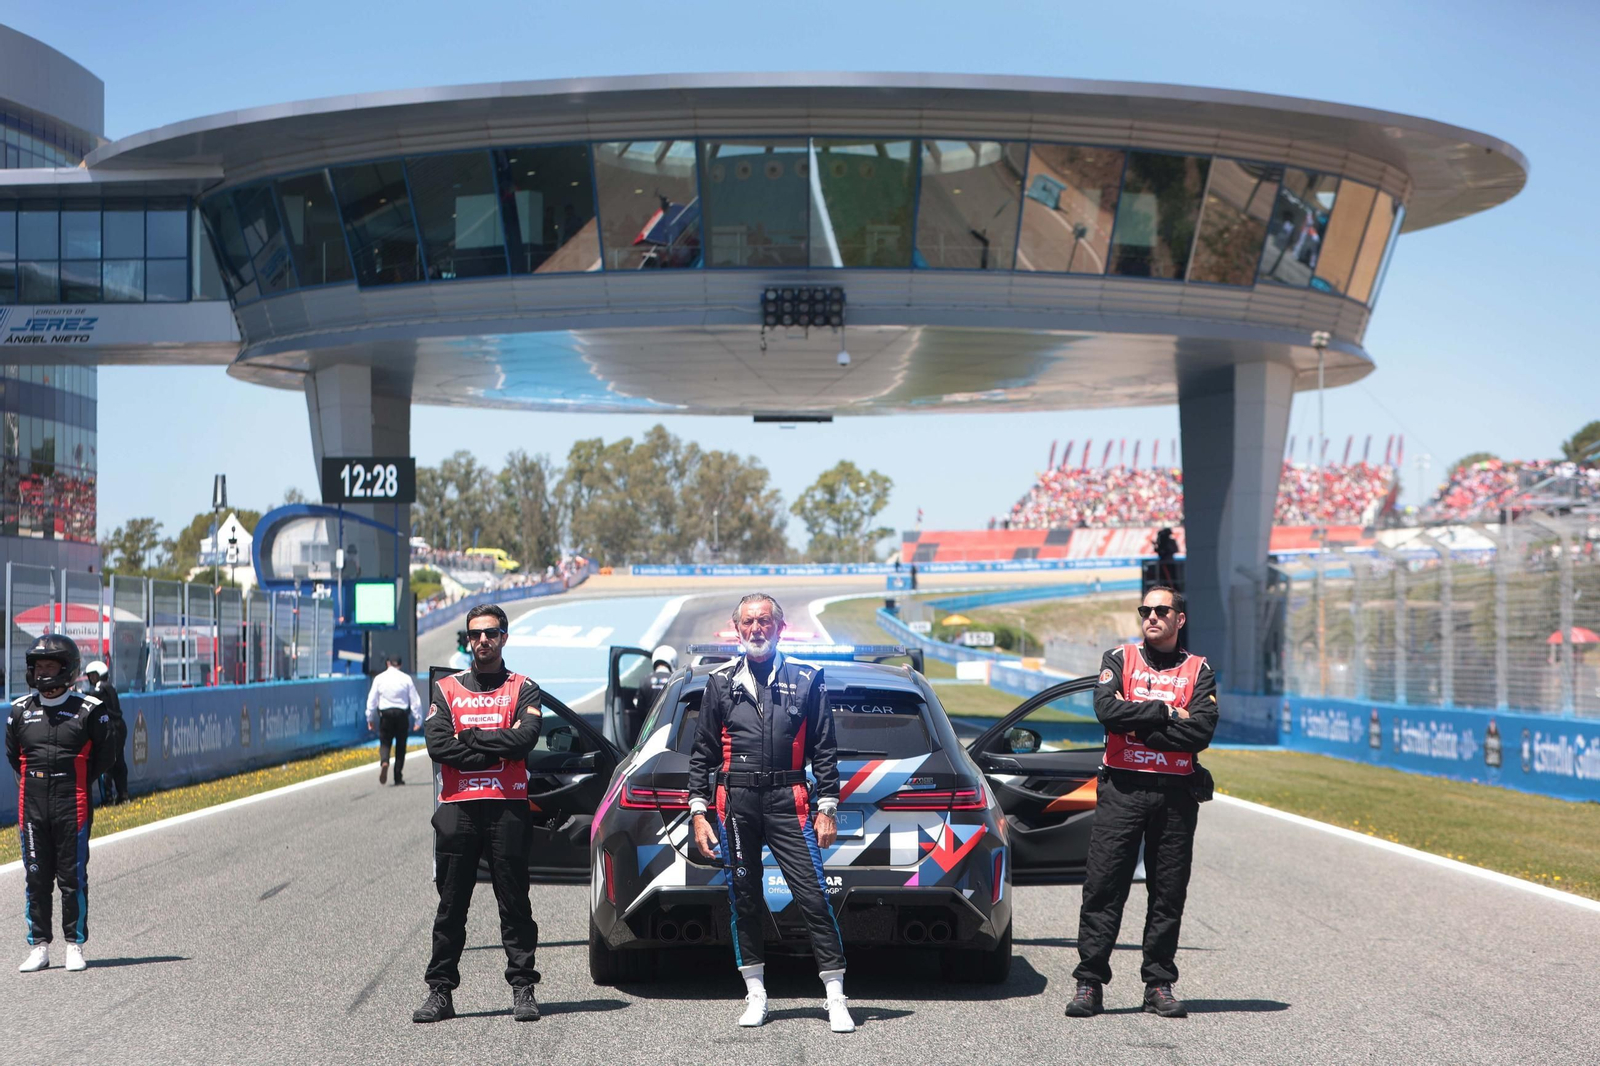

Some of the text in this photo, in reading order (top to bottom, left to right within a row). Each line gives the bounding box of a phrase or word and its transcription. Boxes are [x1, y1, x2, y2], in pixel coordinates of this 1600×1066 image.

[10, 317, 98, 331] JEREZ
[4, 333, 90, 344] ÁNGEL NIETO
[340, 463, 398, 497] 12:28
[58, 625, 97, 635] iemitsu
[452, 695, 511, 708] MotoGP
[829, 703, 894, 714] ETY CAR
[1134, 750, 1168, 765] SPA
[468, 777, 504, 791] SPA
[731, 817, 742, 850] Motorsport
[825, 876, 843, 886] AR
